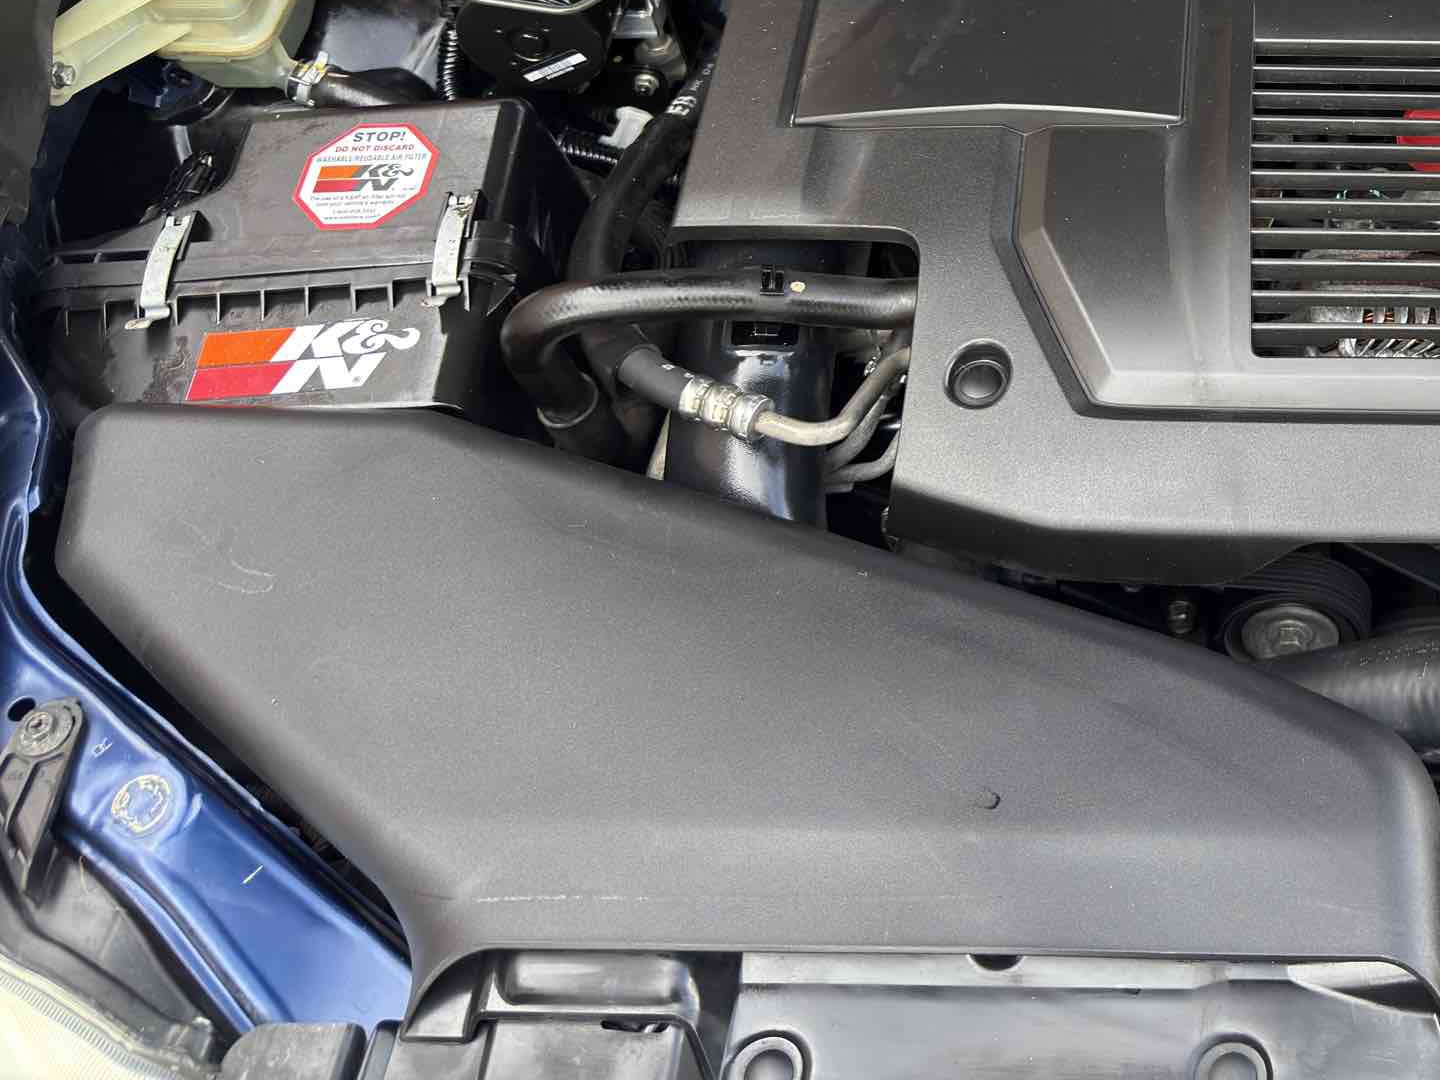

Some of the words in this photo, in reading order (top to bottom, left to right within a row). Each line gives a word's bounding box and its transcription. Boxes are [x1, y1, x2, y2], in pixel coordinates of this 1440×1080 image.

[353, 131, 406, 142] STOP!
[373, 144, 414, 152] DISCARD
[269, 317, 421, 395] K&N
